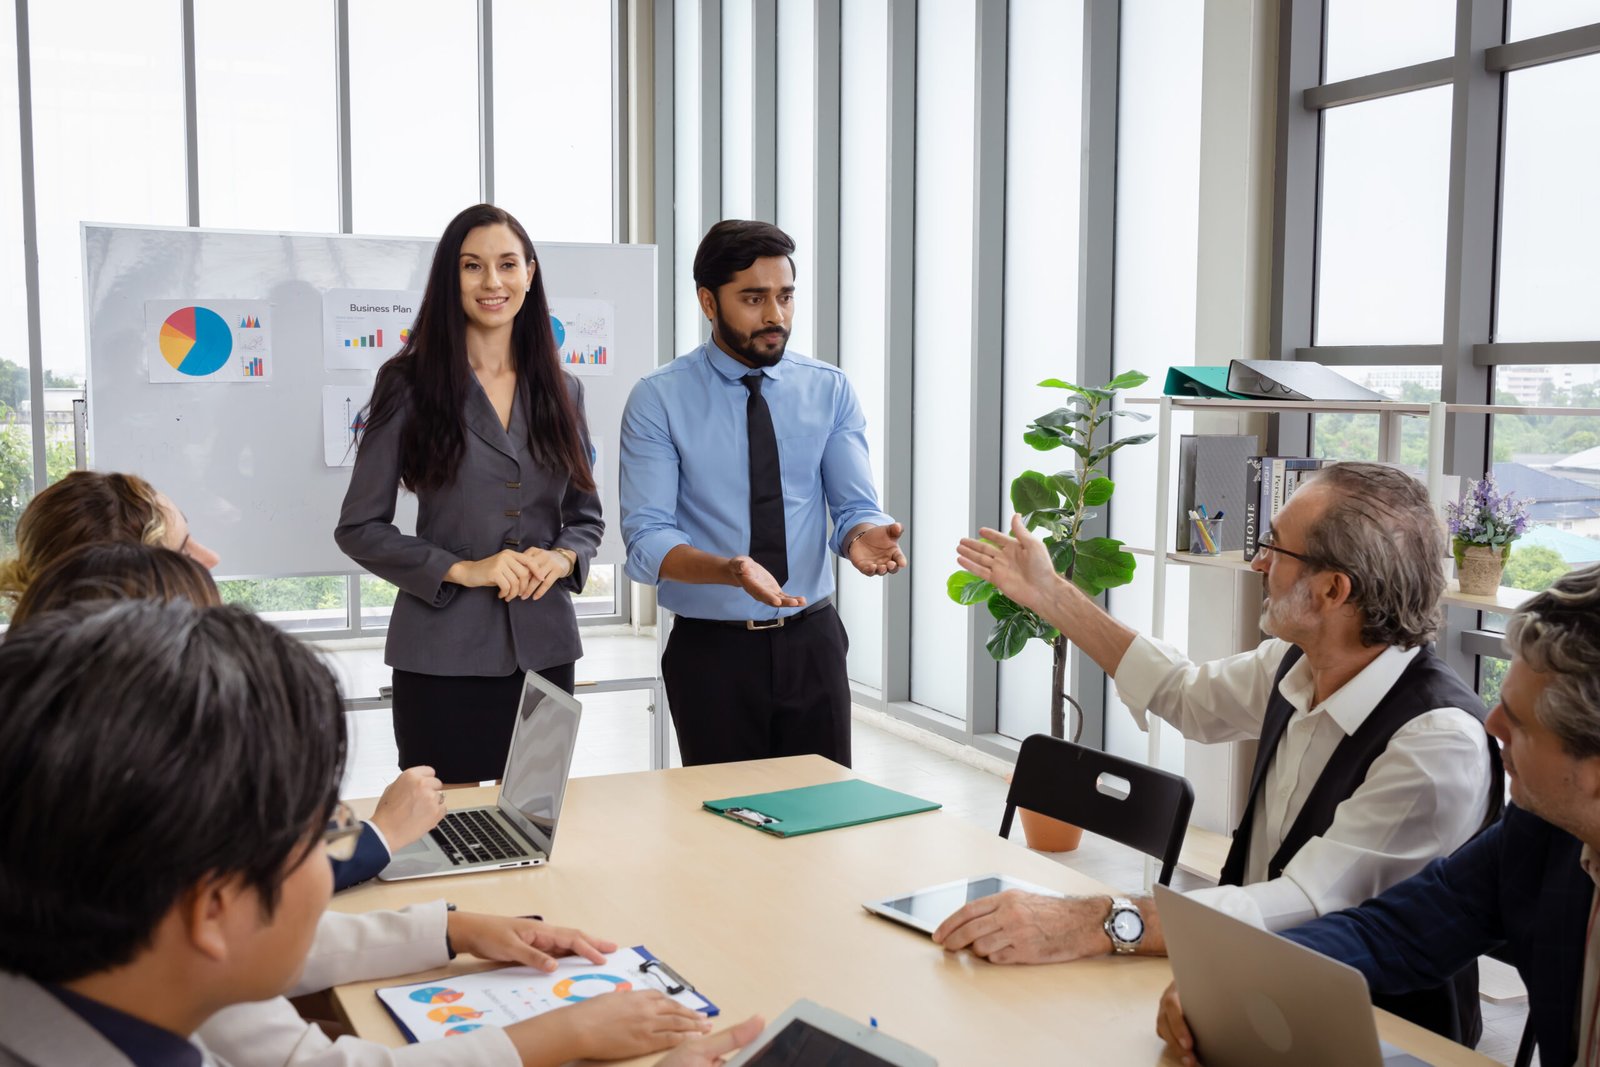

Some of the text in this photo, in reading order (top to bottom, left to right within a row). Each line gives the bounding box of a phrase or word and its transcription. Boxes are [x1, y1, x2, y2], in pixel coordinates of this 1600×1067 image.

[350, 303, 412, 313] Business Plan
[1246, 503, 1255, 545] HOME
